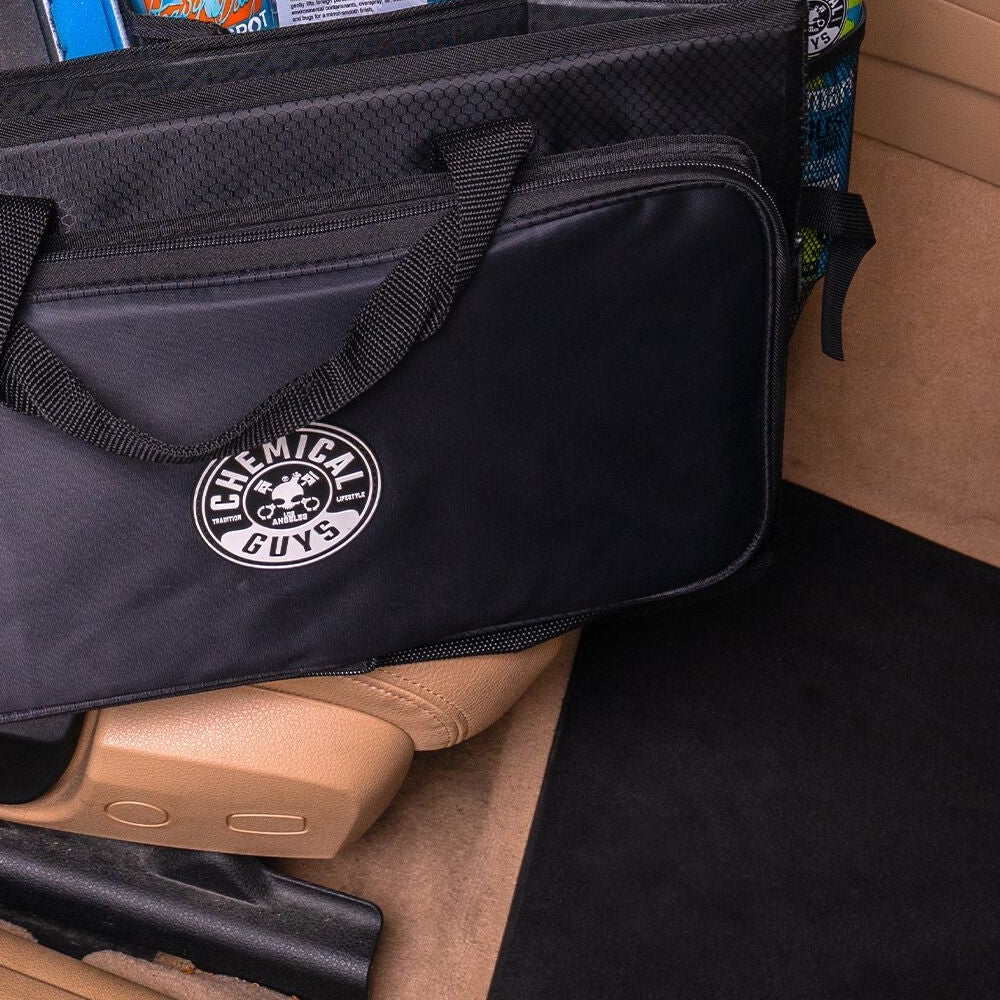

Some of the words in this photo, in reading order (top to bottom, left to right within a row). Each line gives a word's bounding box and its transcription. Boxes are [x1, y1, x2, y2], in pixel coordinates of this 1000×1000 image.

[229, 9, 268, 34] POT
[210, 434, 364, 511] CHEMICAL
[335, 491, 366, 503] LIFESTYLE
[211, 513, 242, 525] TRADITION
[272, 513, 308, 526] ANGELES
[283, 510, 295, 518] LOS
[242, 519, 341, 557] GUYS
